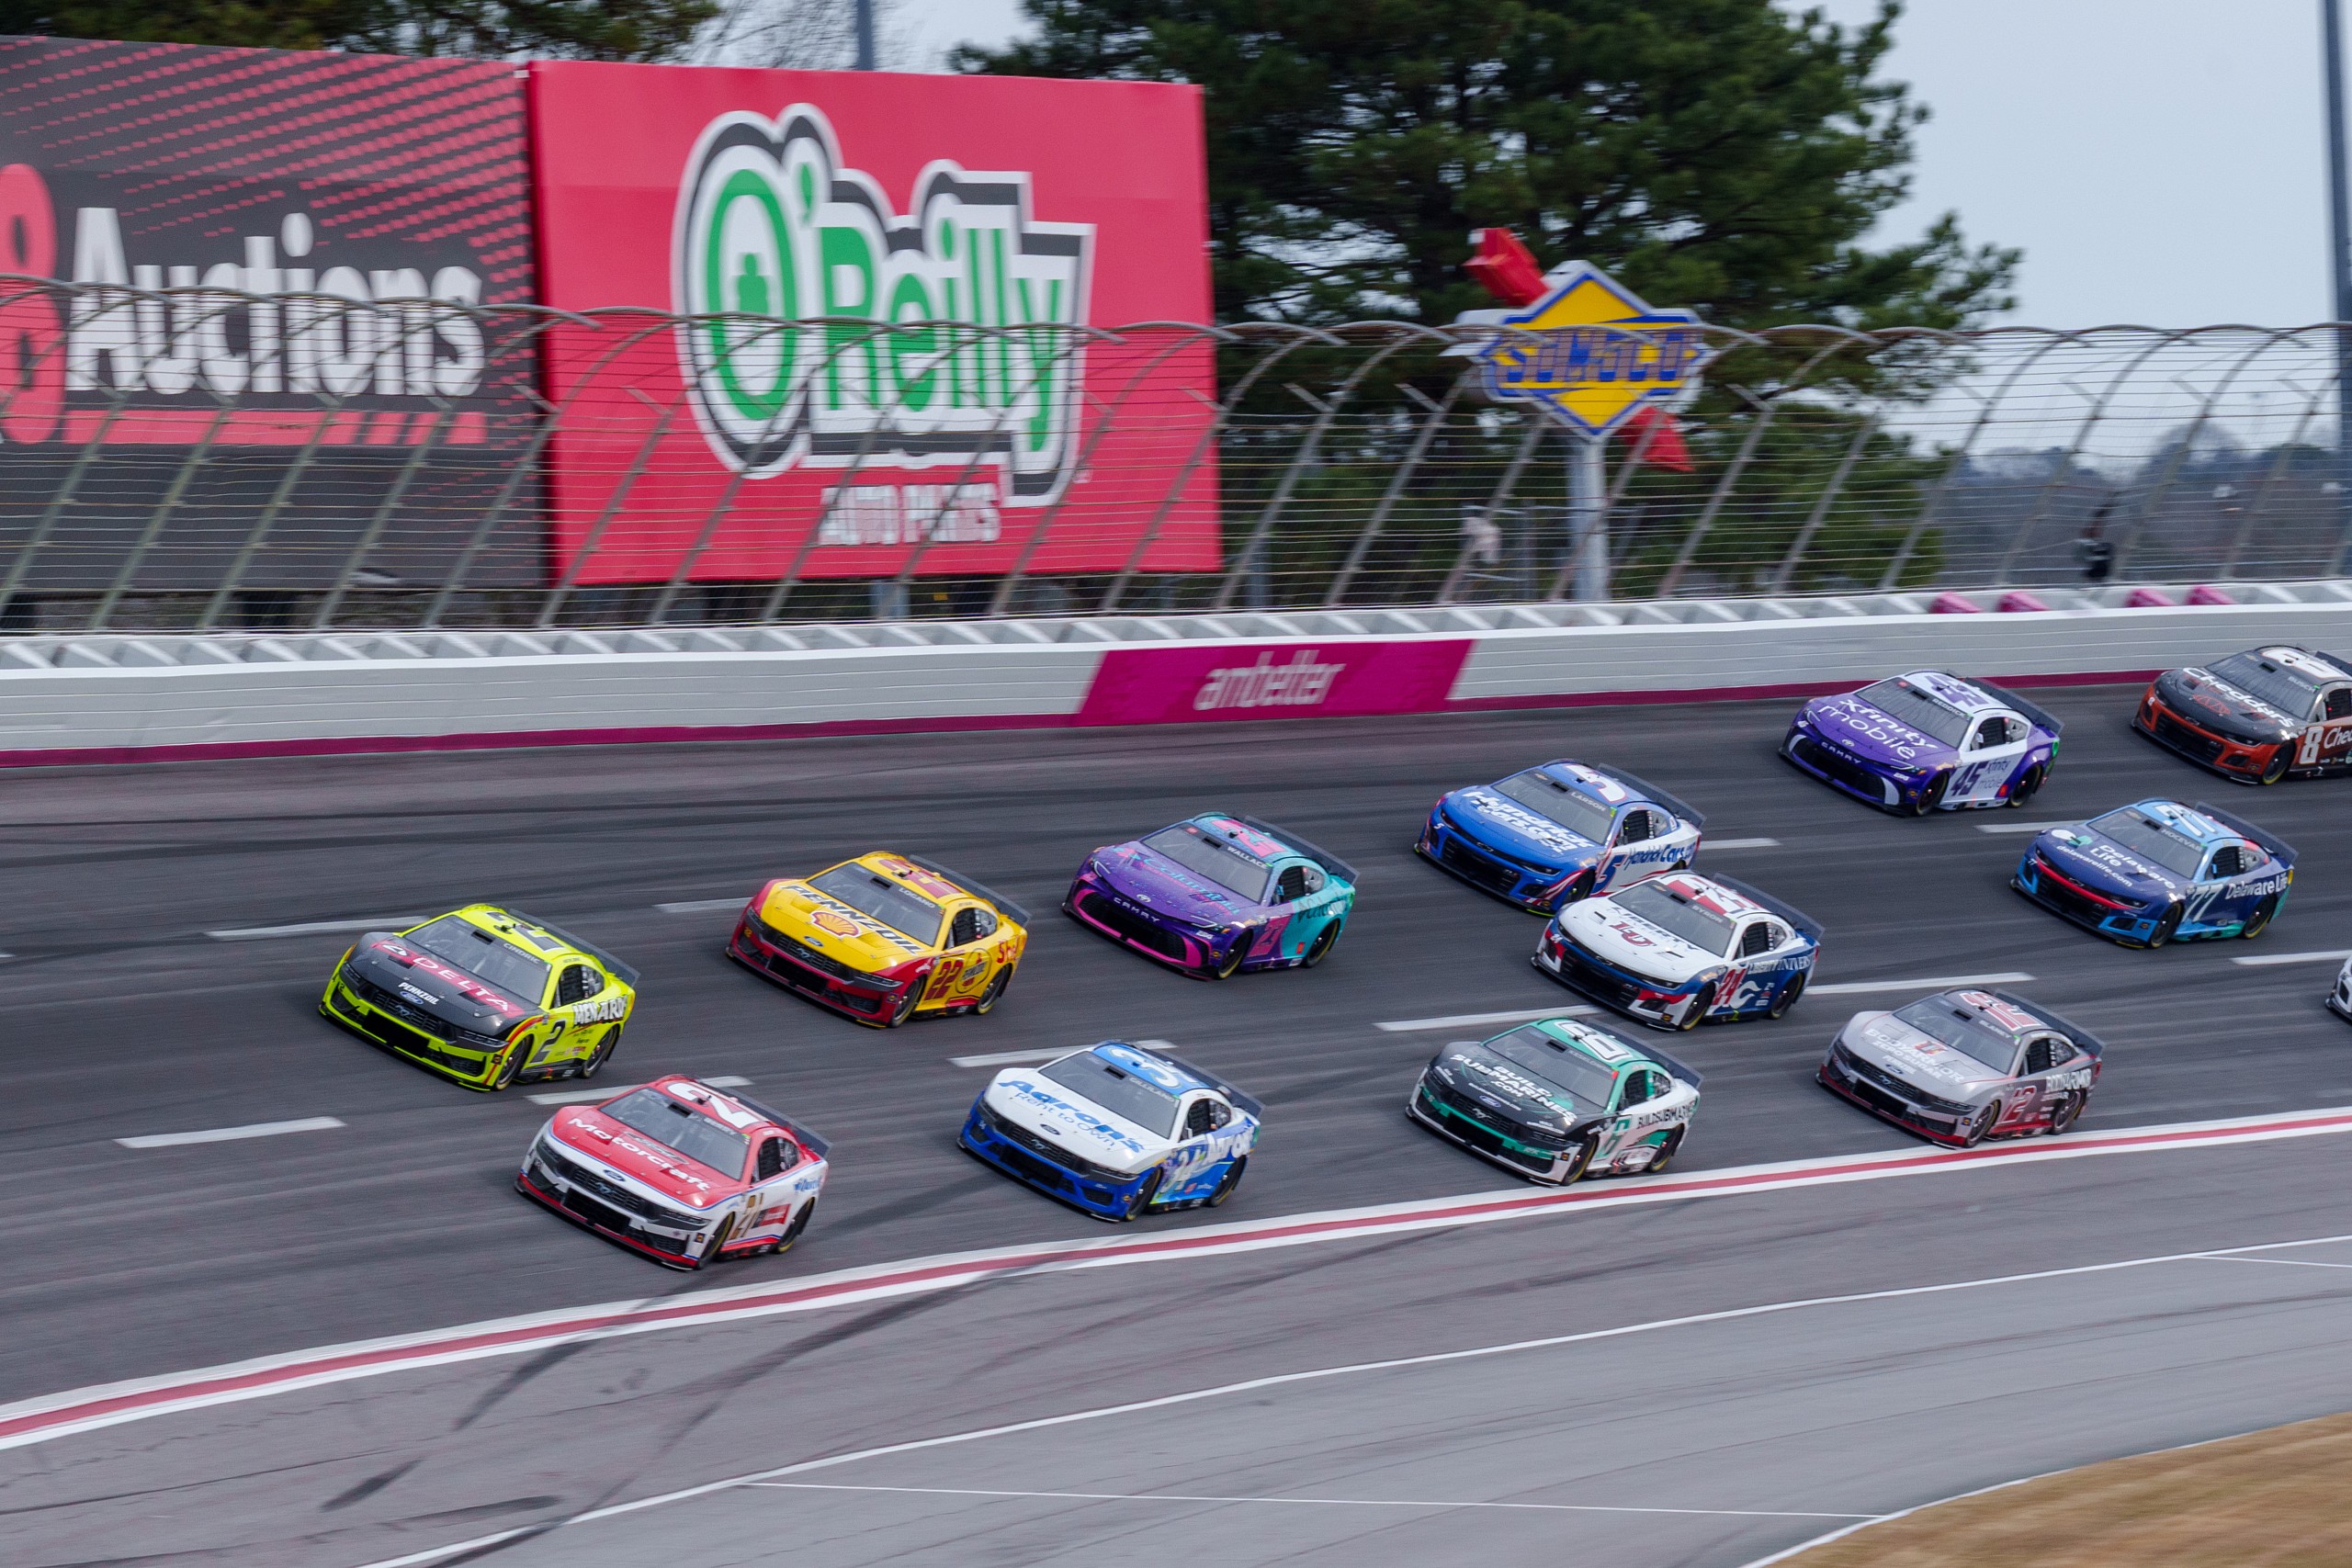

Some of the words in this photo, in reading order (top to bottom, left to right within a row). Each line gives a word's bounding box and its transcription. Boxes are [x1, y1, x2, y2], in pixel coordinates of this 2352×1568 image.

[66, 208, 485, 396] Auctions
[689, 133, 1080, 478] O'Reilly
[1818, 705, 1917, 760] mobile
[1821, 741, 1862, 764] CAMRY
[2299, 725, 2324, 765] 8
[1951, 761, 1990, 796] 45
[1570, 791, 1606, 812] LARSON
[1227, 846, 1269, 870] WALLACE
[2089, 847, 2122, 867] Life
[2098, 843, 2177, 890] Delaware
[899, 887, 936, 908] LOGANO
[1113, 897, 1160, 922] CAMRY
[2179, 883, 2224, 923] 77
[781, 884, 925, 956] PENNZOIL
[503, 942, 540, 964] CINDRIC
[398, 982, 440, 1005] PENNZOIL
[413, 956, 510, 1011] DELTA
[924, 960, 965, 1001] 22
[528, 1019, 567, 1065] 2
[1450, 1054, 1578, 1126] SUBMARINES
[568, 1118, 711, 1192] Motorcraft
